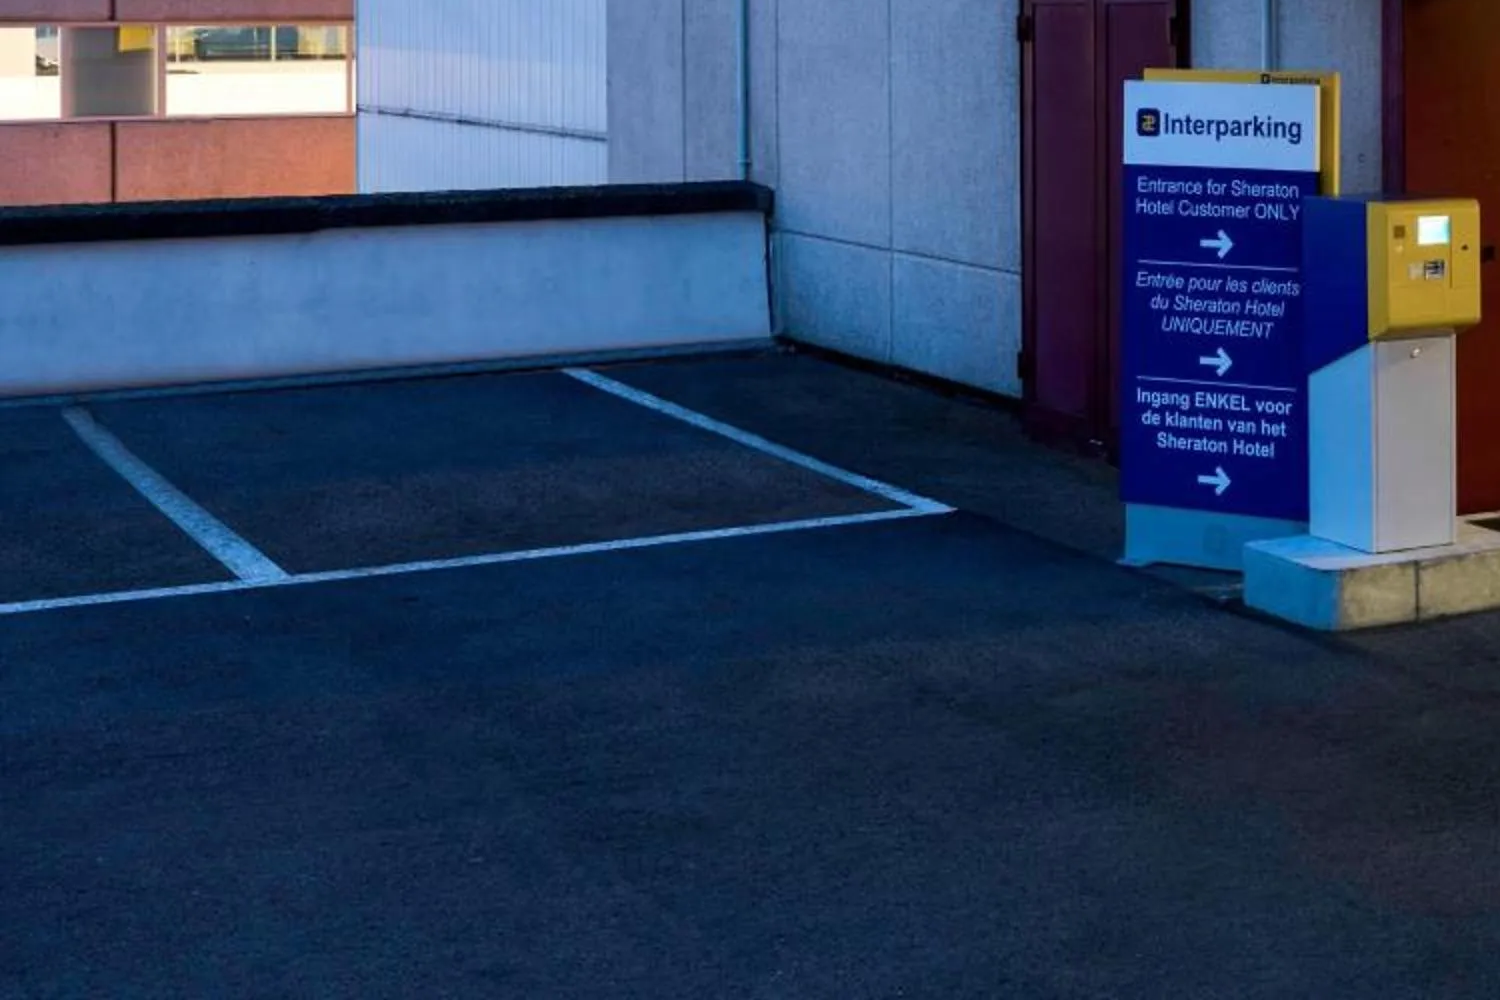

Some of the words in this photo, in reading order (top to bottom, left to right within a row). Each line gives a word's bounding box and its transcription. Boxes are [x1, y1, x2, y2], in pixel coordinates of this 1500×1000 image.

[1164, 112, 1303, 145] Interparking
[1137, 175, 1203, 195] Entrance
[1207, 178, 1227, 196] for
[1231, 179, 1299, 199] Sheraton
[1136, 197, 1174, 215] Hotel
[1178, 199, 1250, 219] Customer
[1254, 202, 1300, 220] ONLY
[1187, 276, 1223, 293] pour
[1225, 275, 1249, 293] les
[1252, 277, 1300, 296] clients
[1150, 293, 1169, 310] du
[1173, 294, 1241, 315] Sheraton
[1244, 299, 1286, 317] Hotel
[1161, 314, 1275, 339] UNIQUEMENT
[1136, 387, 1191, 410] Ingang
[1195, 391, 1251, 412] ENKEL
[1255, 400, 1293, 415] voor
[1141, 409, 1161, 426] de
[1165, 411, 1223, 432] klanten
[1227, 419, 1256, 435] van
[1261, 419, 1287, 437] het
[1157, 431, 1228, 453] Sheraton
[1233, 439, 1275, 458] Hotel
